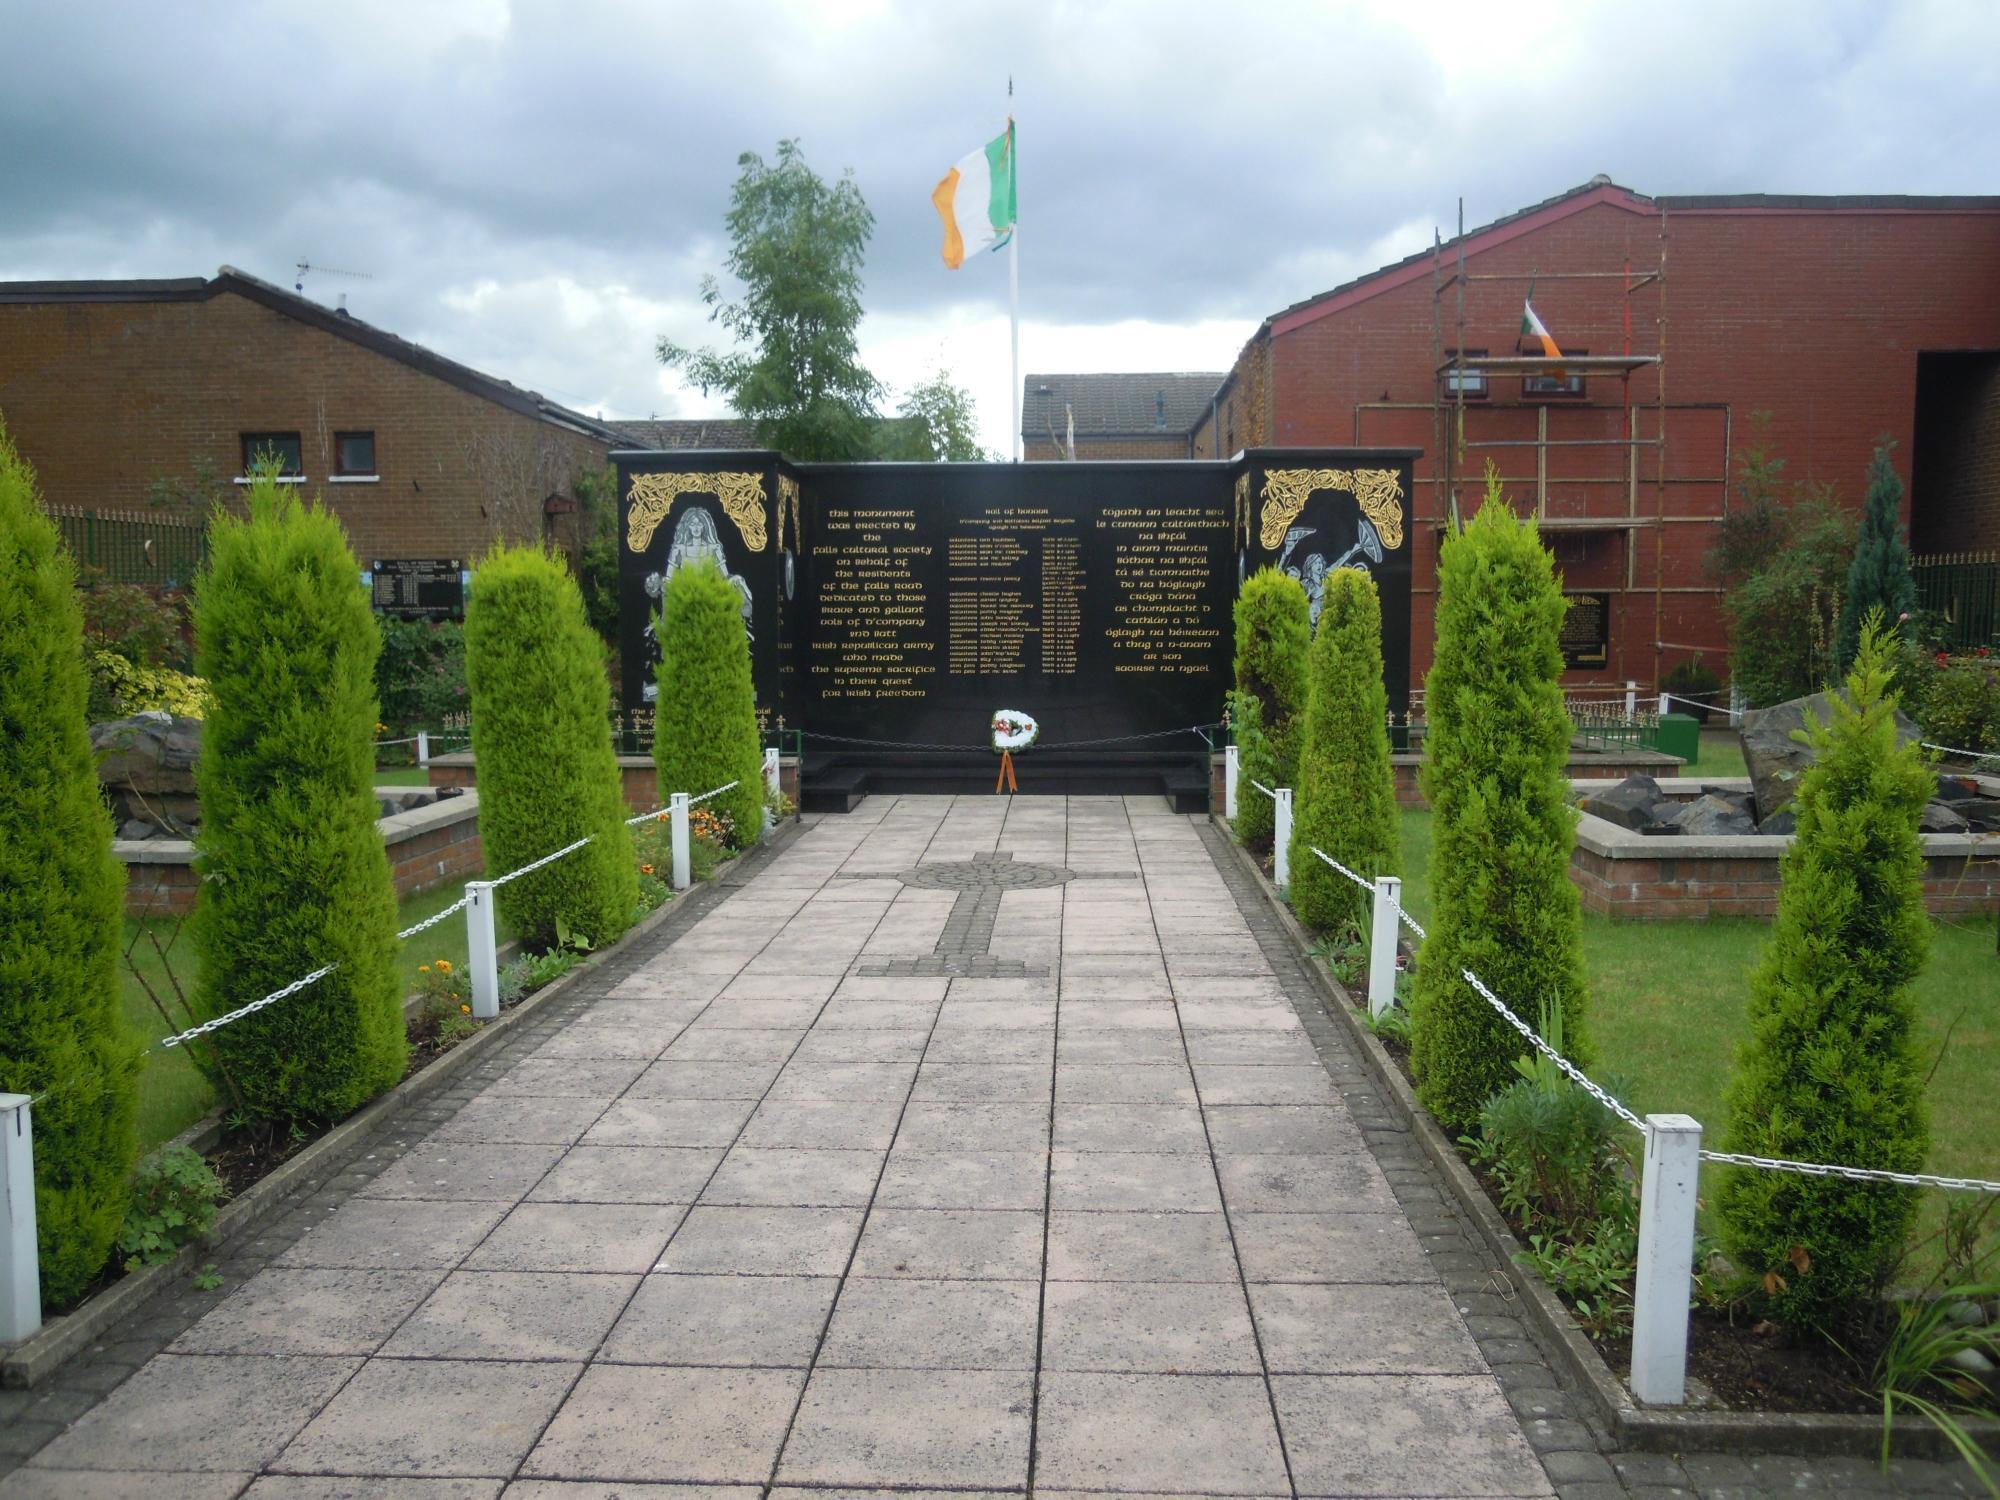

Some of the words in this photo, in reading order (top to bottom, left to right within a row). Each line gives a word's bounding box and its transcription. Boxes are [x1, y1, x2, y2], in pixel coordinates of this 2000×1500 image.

[828, 509, 850, 517] this
[1004, 508, 1014, 516] of
[902, 522, 917, 531] by
[862, 533, 882, 541] the
[812, 546, 839, 555] falls
[842, 545, 889, 554] cultural
[892, 546, 933, 555] society
[854, 557, 891, 567] behalf
[894, 558, 909, 567] of
[822, 583, 837, 591] of
[863, 582, 890, 591] falls
[895, 593, 927, 601] those
[884, 605, 925, 615] gallant
[846, 618, 861, 627] of
[873, 630, 897, 638] batt
[841, 642, 899, 650] republican
[886, 666, 936, 675] sacrifice
[881, 678, 913, 686] quest
[821, 690, 842, 698] for
[875, 690, 926, 698] freedom
